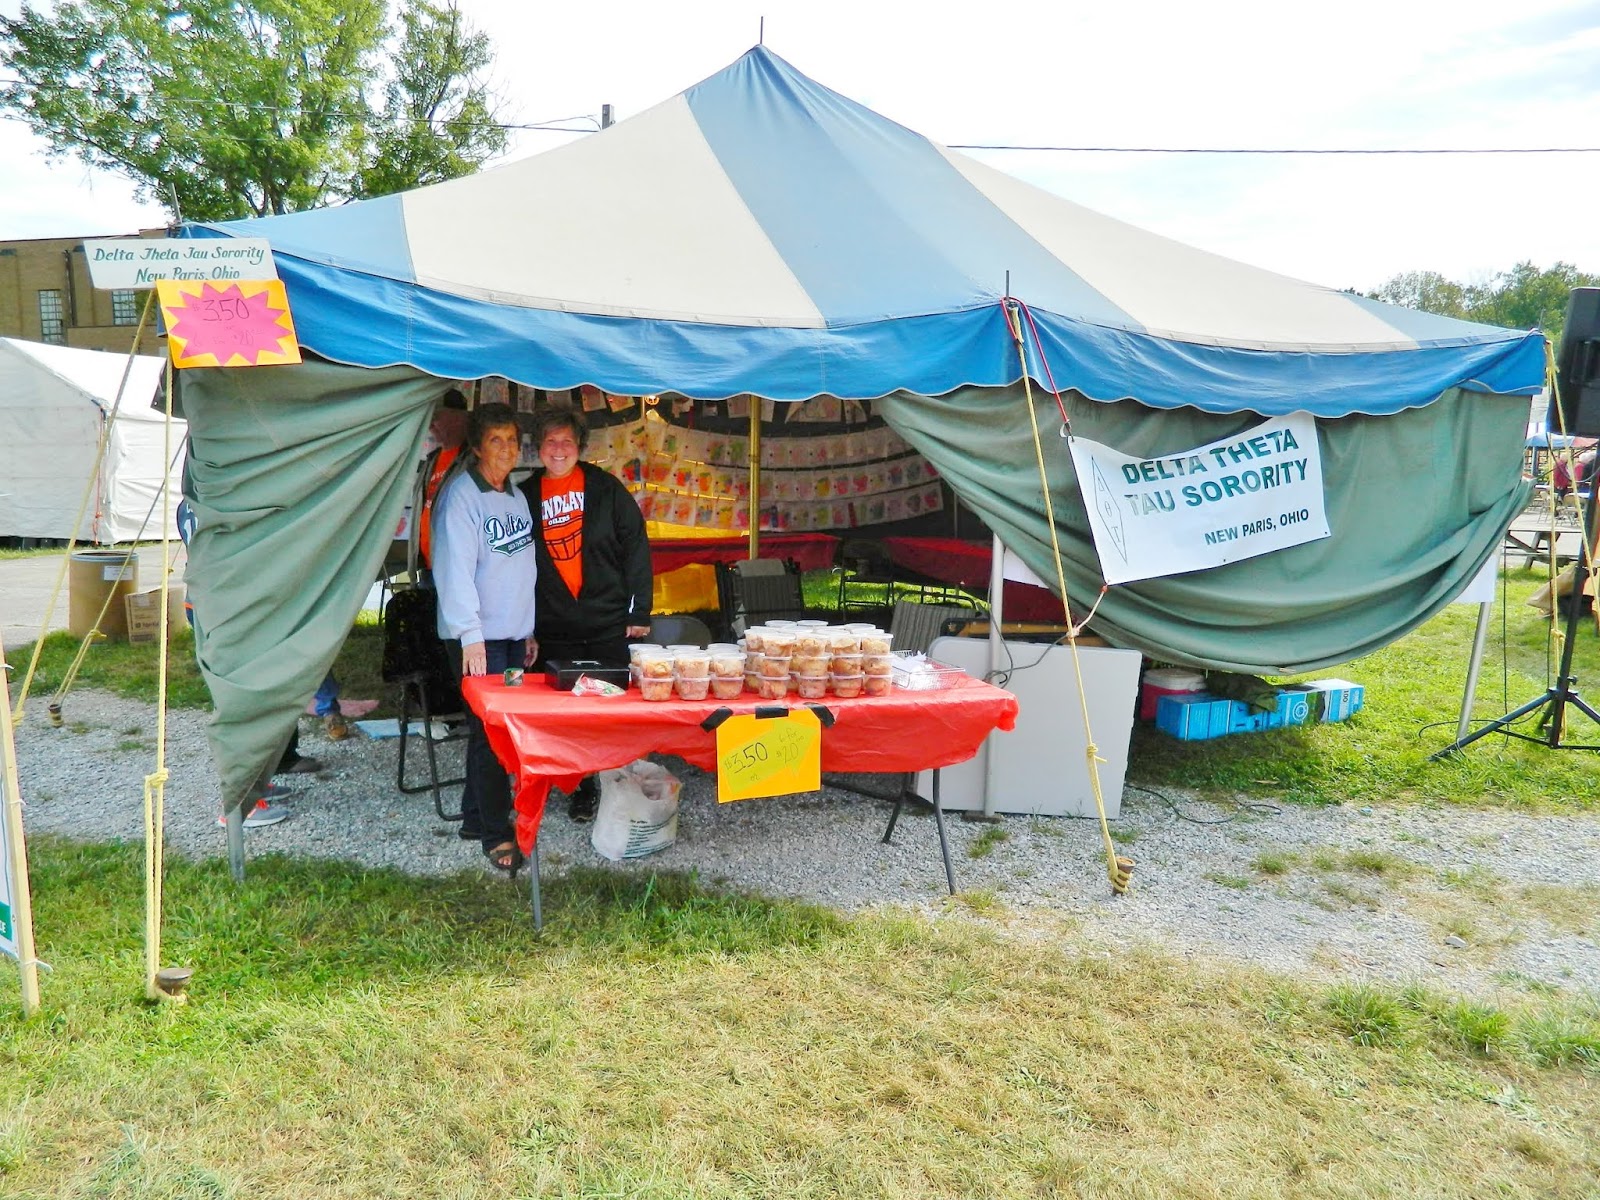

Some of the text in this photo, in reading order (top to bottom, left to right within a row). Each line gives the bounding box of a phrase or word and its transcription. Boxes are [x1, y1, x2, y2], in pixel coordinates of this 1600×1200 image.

[93, 246, 265, 265] Delta Theta Tau Sorority
[135, 267, 167, 285] New
[211, 265, 240, 280] Ohio
[1121, 428, 1299, 484] DELTA THETA
[1124, 489, 1176, 516] TAU
[1181, 458, 1309, 507] SORORITY
[1204, 508, 1310, 545] NEW PARIS, OHIO
